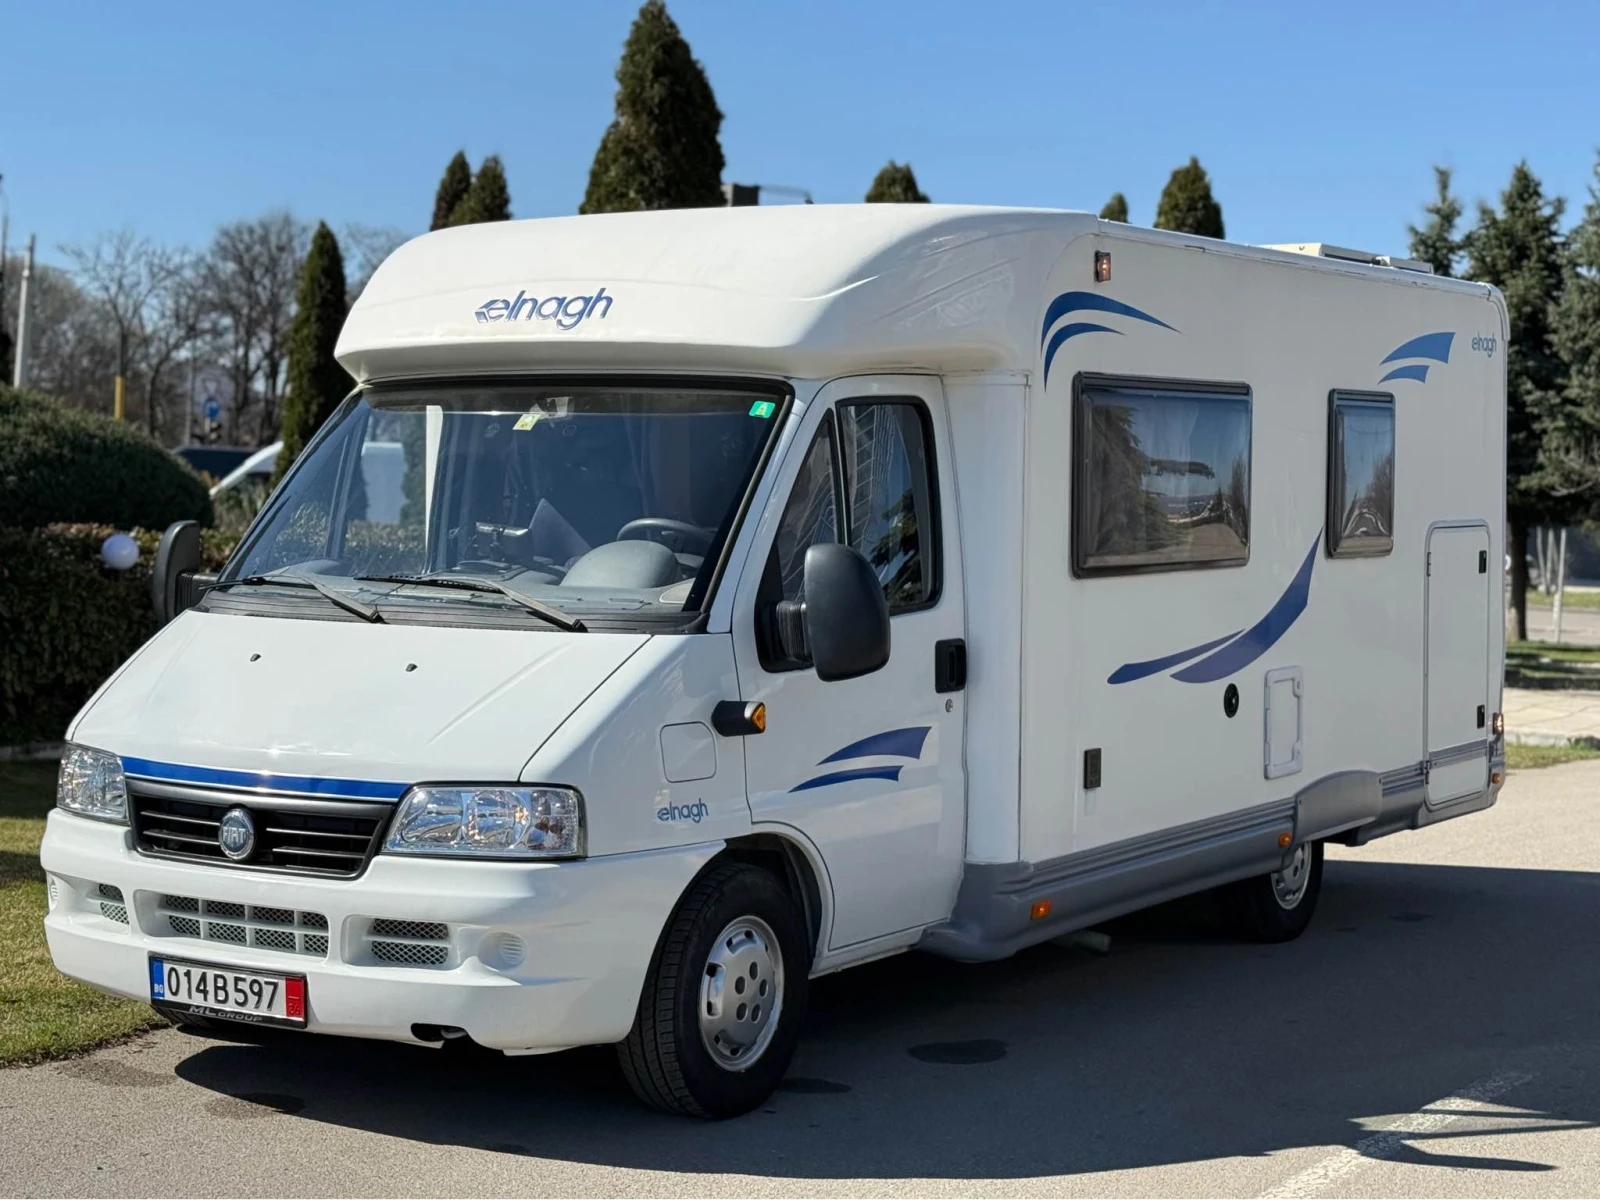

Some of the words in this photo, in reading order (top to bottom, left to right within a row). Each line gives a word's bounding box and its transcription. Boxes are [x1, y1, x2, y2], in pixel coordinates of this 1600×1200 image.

[475, 287, 613, 330] elnagh
[1471, 330, 1497, 358] elnagh
[657, 797, 708, 823] elnagh
[223, 826, 246, 844] FIAT
[189, 1005, 216, 1016] ML
[217, 1011, 263, 1021] GROUP
